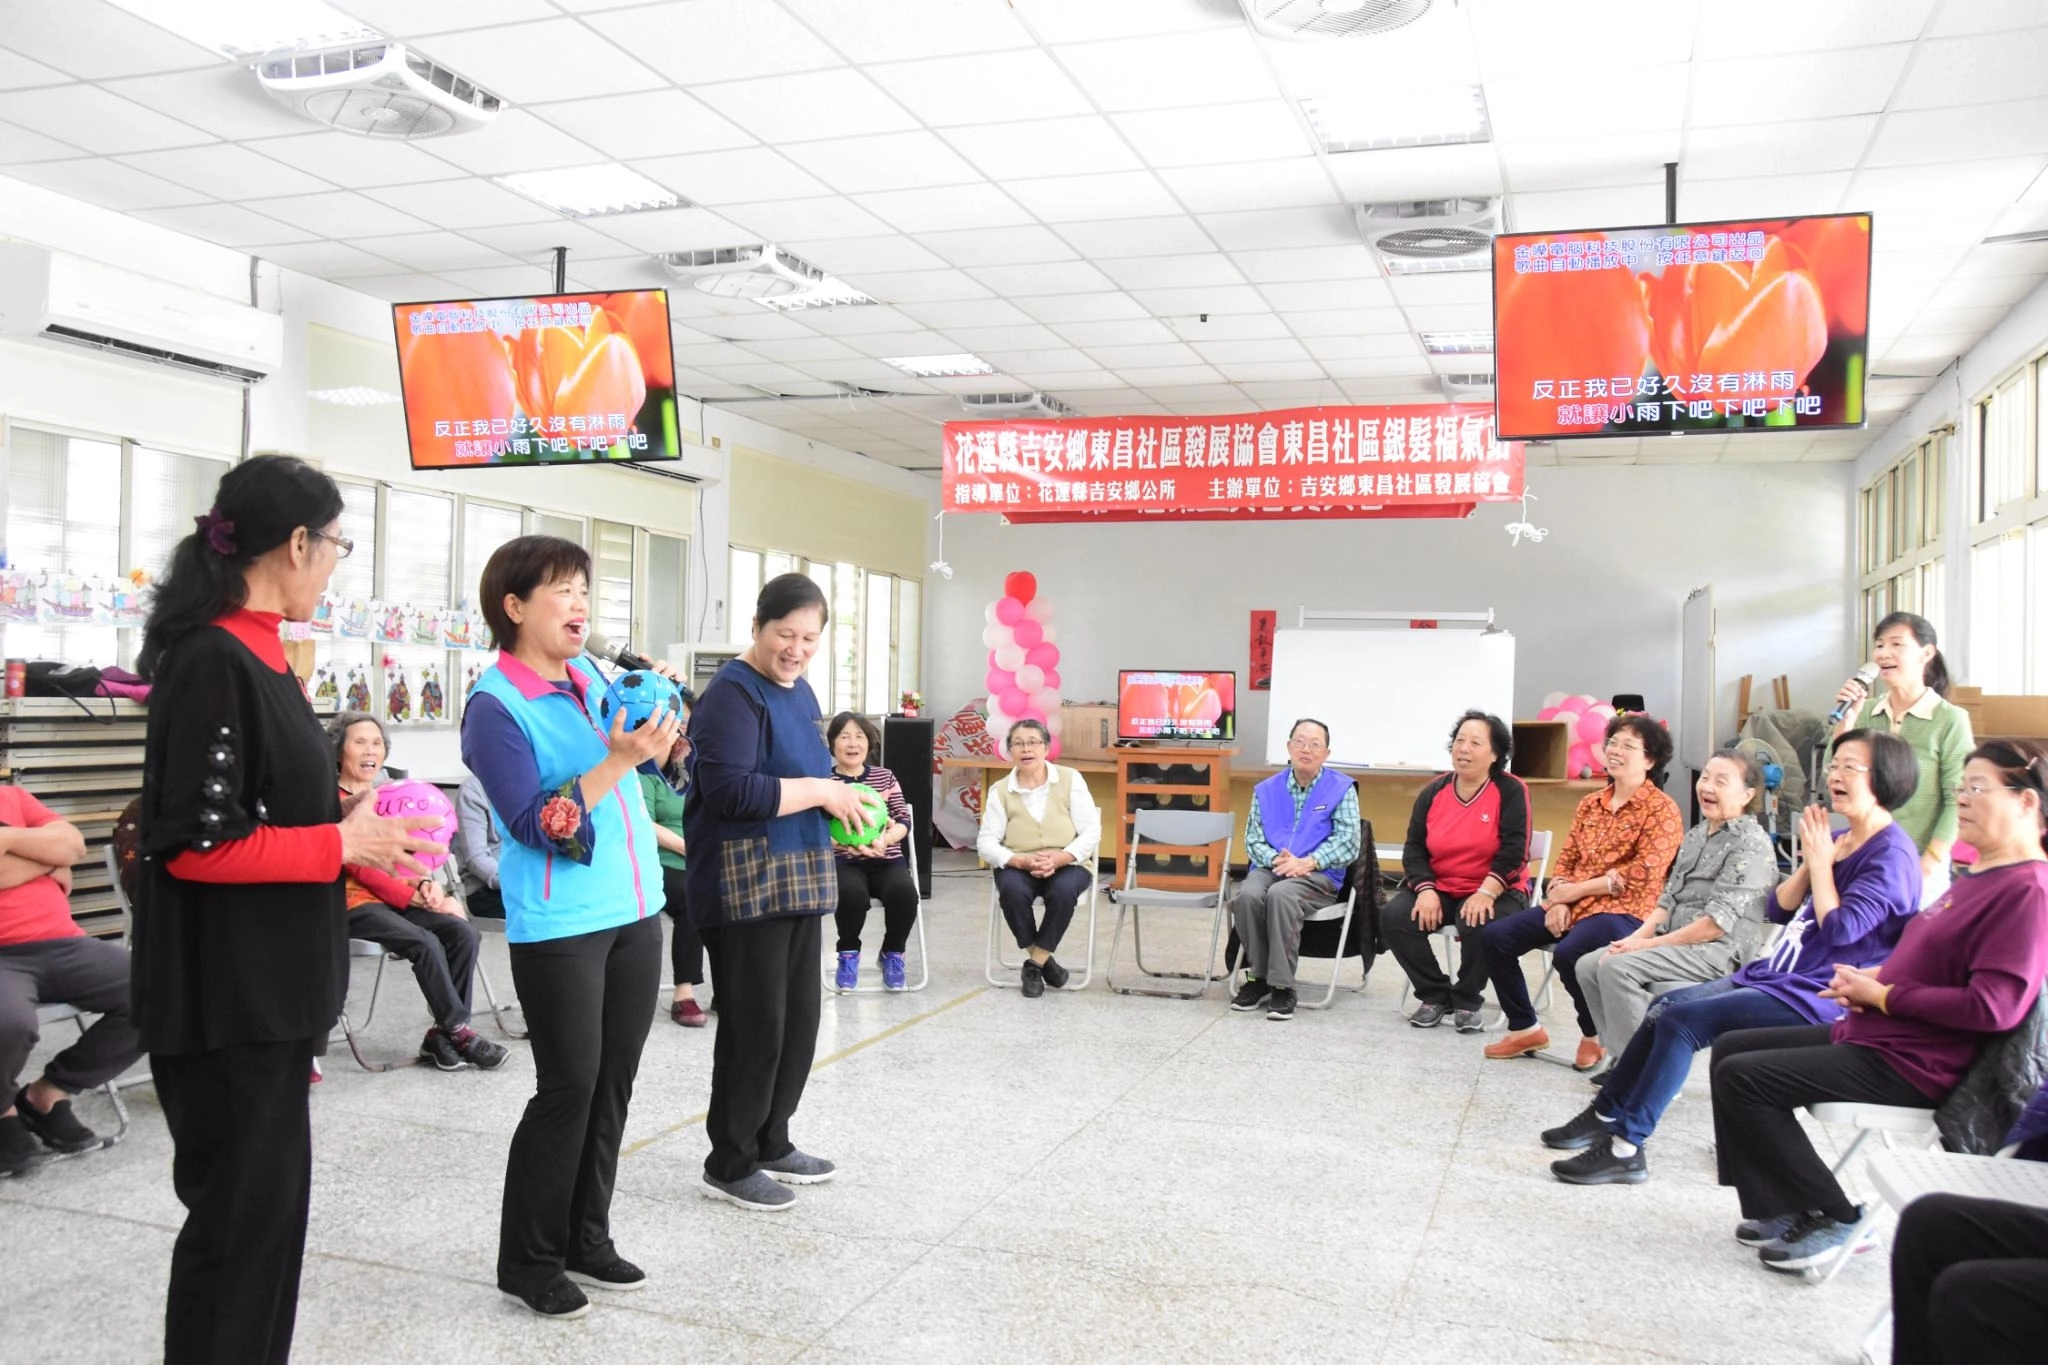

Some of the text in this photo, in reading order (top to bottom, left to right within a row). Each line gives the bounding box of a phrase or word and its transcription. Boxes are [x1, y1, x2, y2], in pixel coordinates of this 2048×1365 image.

[1532, 371, 1795, 399] 反正我已好久沒有淋雨
[434, 414, 626, 437] 反正我已好久沒有淋雨
